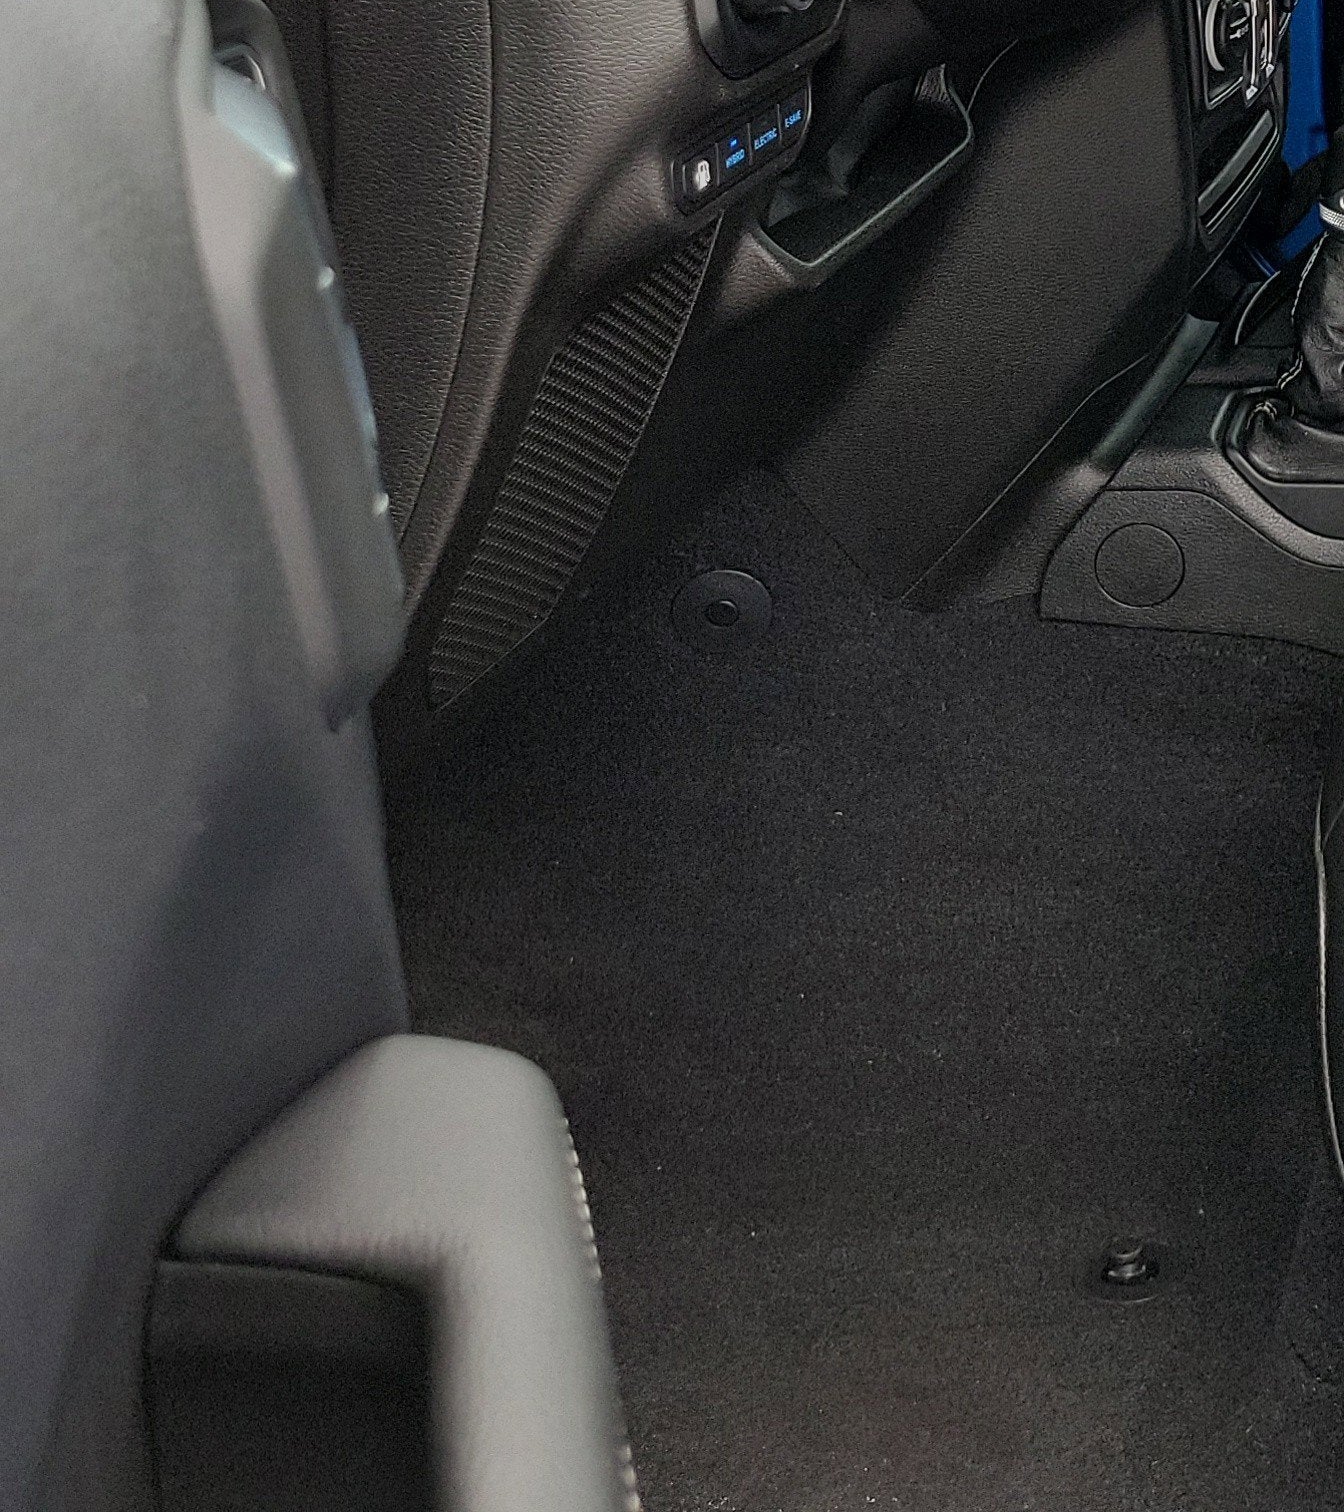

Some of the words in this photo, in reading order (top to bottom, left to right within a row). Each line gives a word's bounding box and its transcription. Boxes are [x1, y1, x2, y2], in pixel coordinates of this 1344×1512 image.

[784, 109, 802, 128] E-SAVE
[754, 128, 778, 150] ELECTRIC
[725, 149, 745, 168] HYBRID
